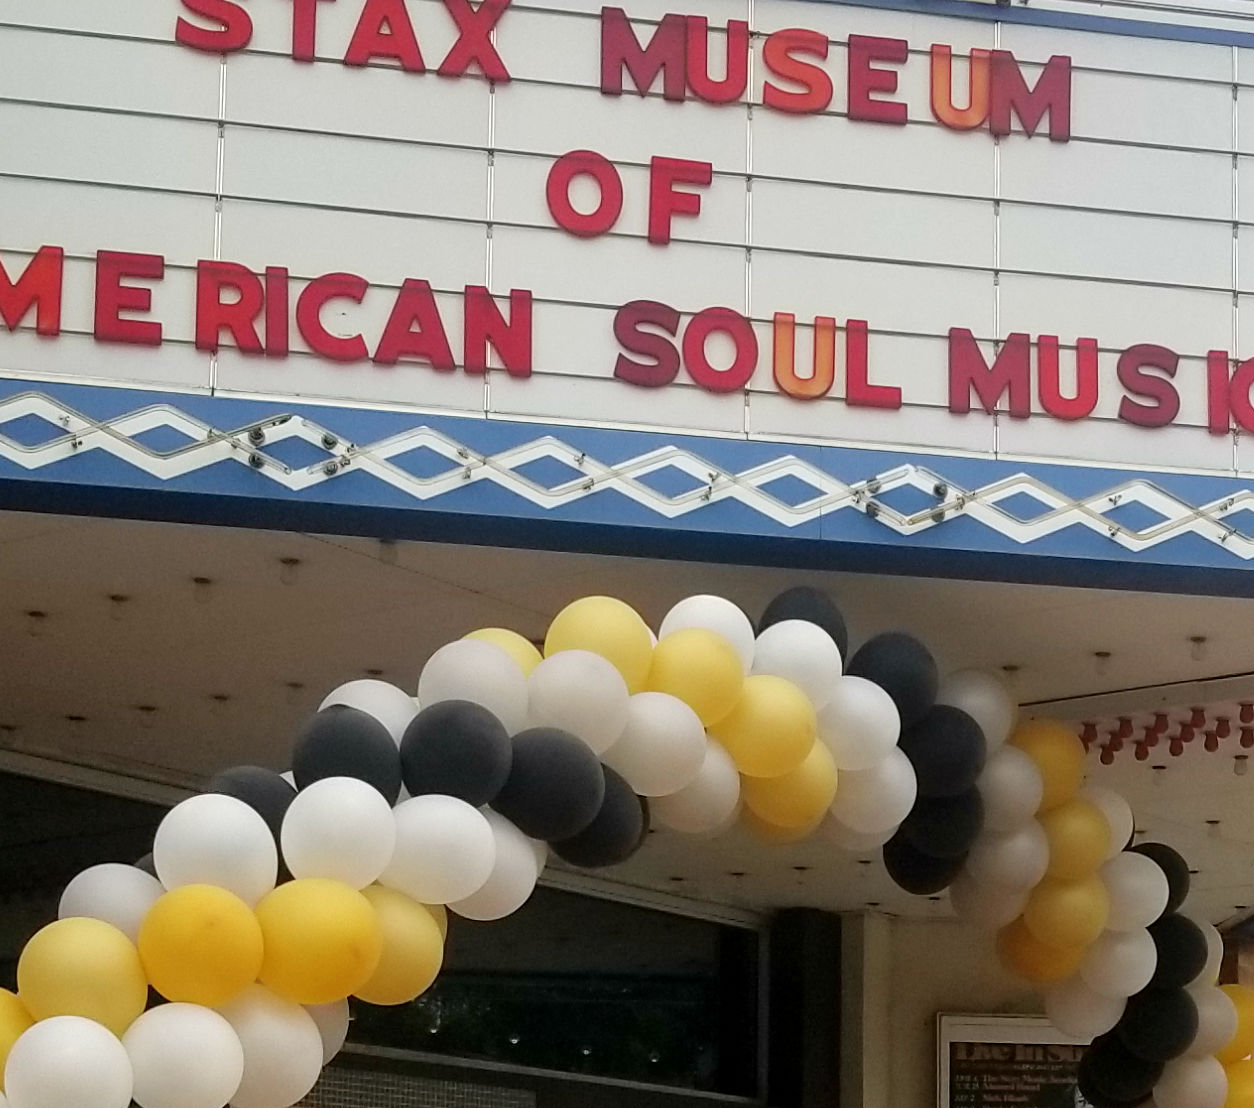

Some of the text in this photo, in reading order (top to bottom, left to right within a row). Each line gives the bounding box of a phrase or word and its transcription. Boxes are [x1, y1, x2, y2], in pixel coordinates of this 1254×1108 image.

[175, 0, 1072, 143] STAX MUSEUM
[545, 149, 713, 246] OF
[614, 299, 902, 411] SOUL
